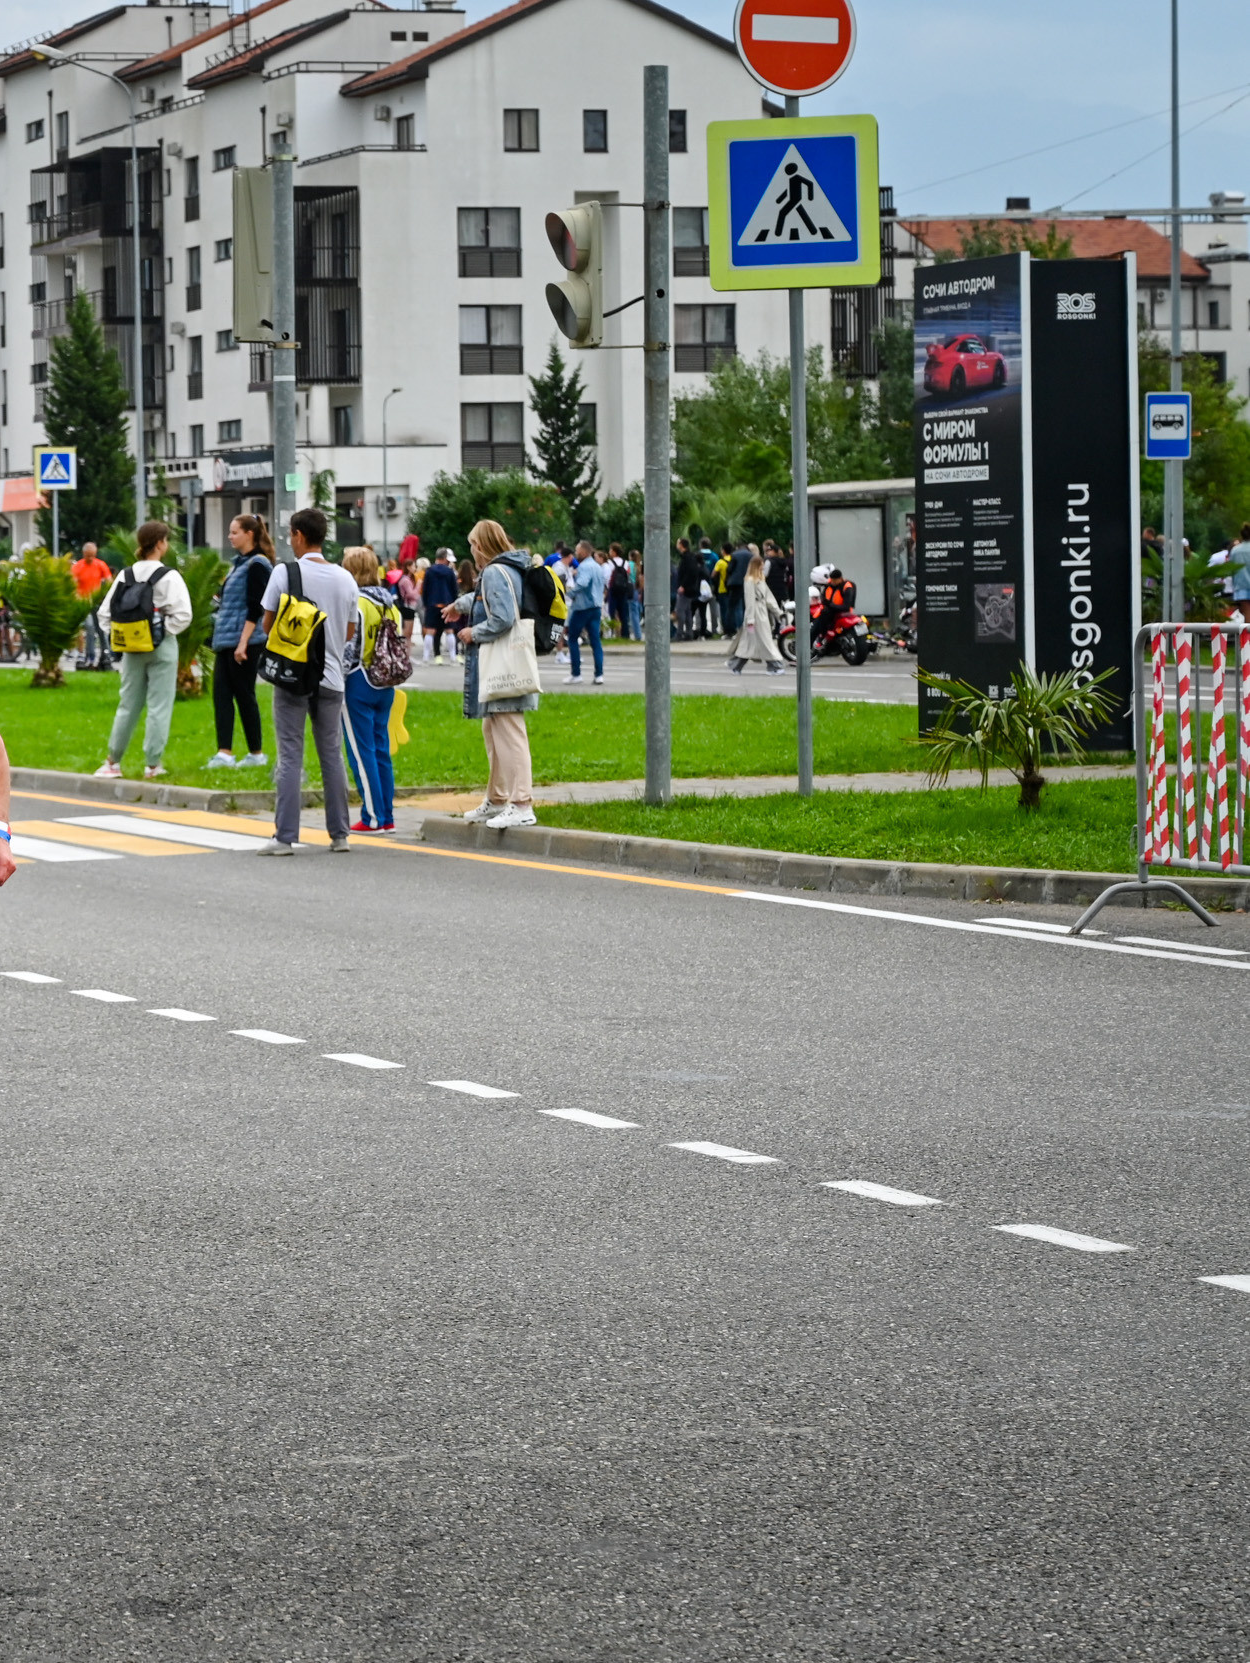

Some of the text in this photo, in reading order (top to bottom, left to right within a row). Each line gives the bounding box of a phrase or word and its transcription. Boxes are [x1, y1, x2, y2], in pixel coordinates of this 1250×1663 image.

[923, 275, 995, 299] СОЧИ АВТОДРОМ
[1057, 292, 1096, 313] ROS
[923, 418, 976, 441] С МИРОМ
[923, 441, 989, 464] ФОРМУЛЫ 1
[926, 468, 988, 480] НА СОЧИ АВТОДРОМЕ
[486, 678, 533, 691] ОБЫЧНОГО
